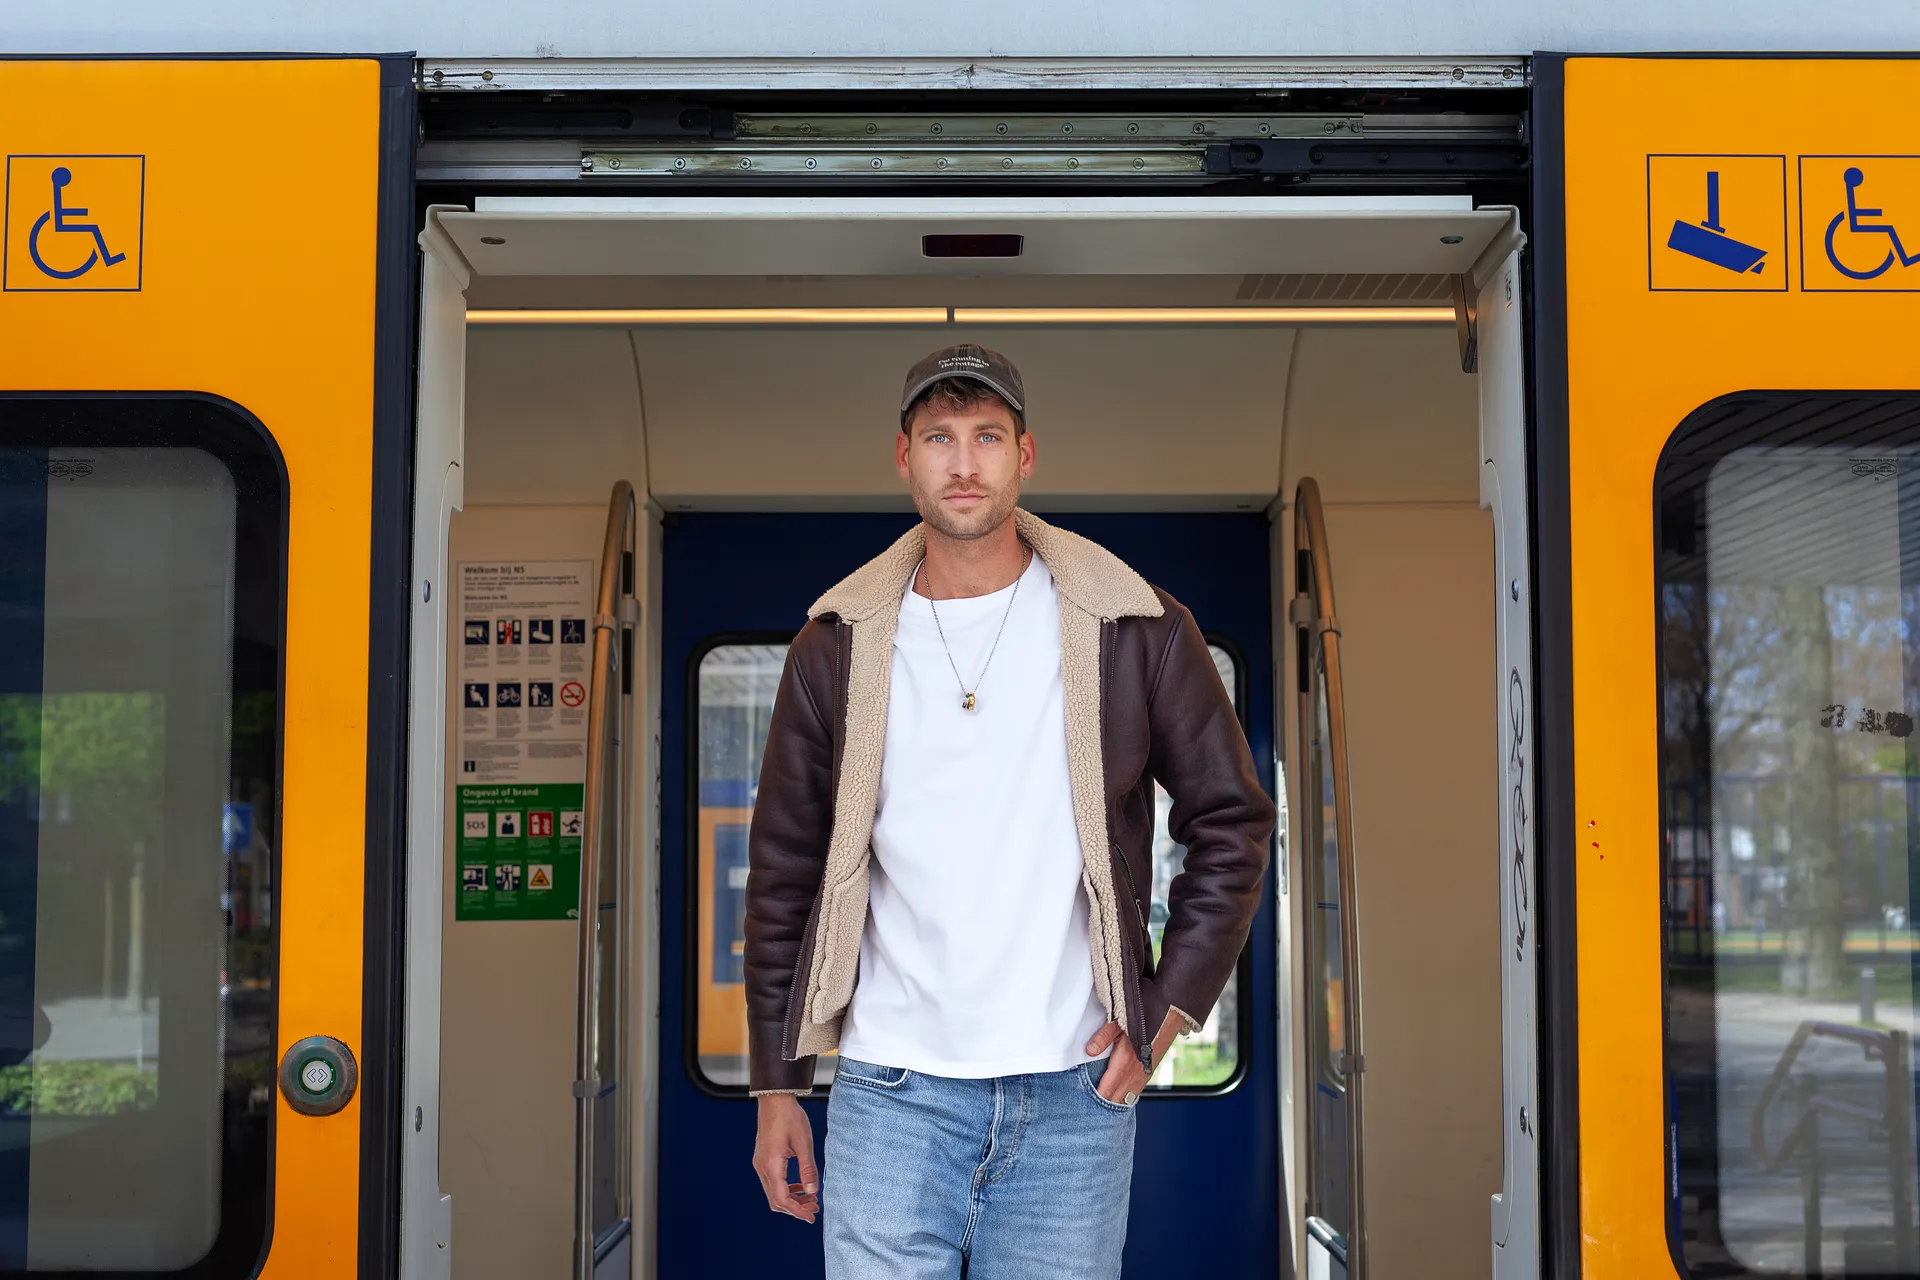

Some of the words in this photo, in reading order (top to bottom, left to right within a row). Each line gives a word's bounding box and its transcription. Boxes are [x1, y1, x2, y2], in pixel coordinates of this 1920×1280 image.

[464, 566, 498, 574] Welkom
[500, 566, 511, 575] bij
[462, 788, 499, 798] Ongeval
[500, 787, 511, 797] of
[512, 787, 539, 797] brand
[466, 820, 486, 830] SOS
